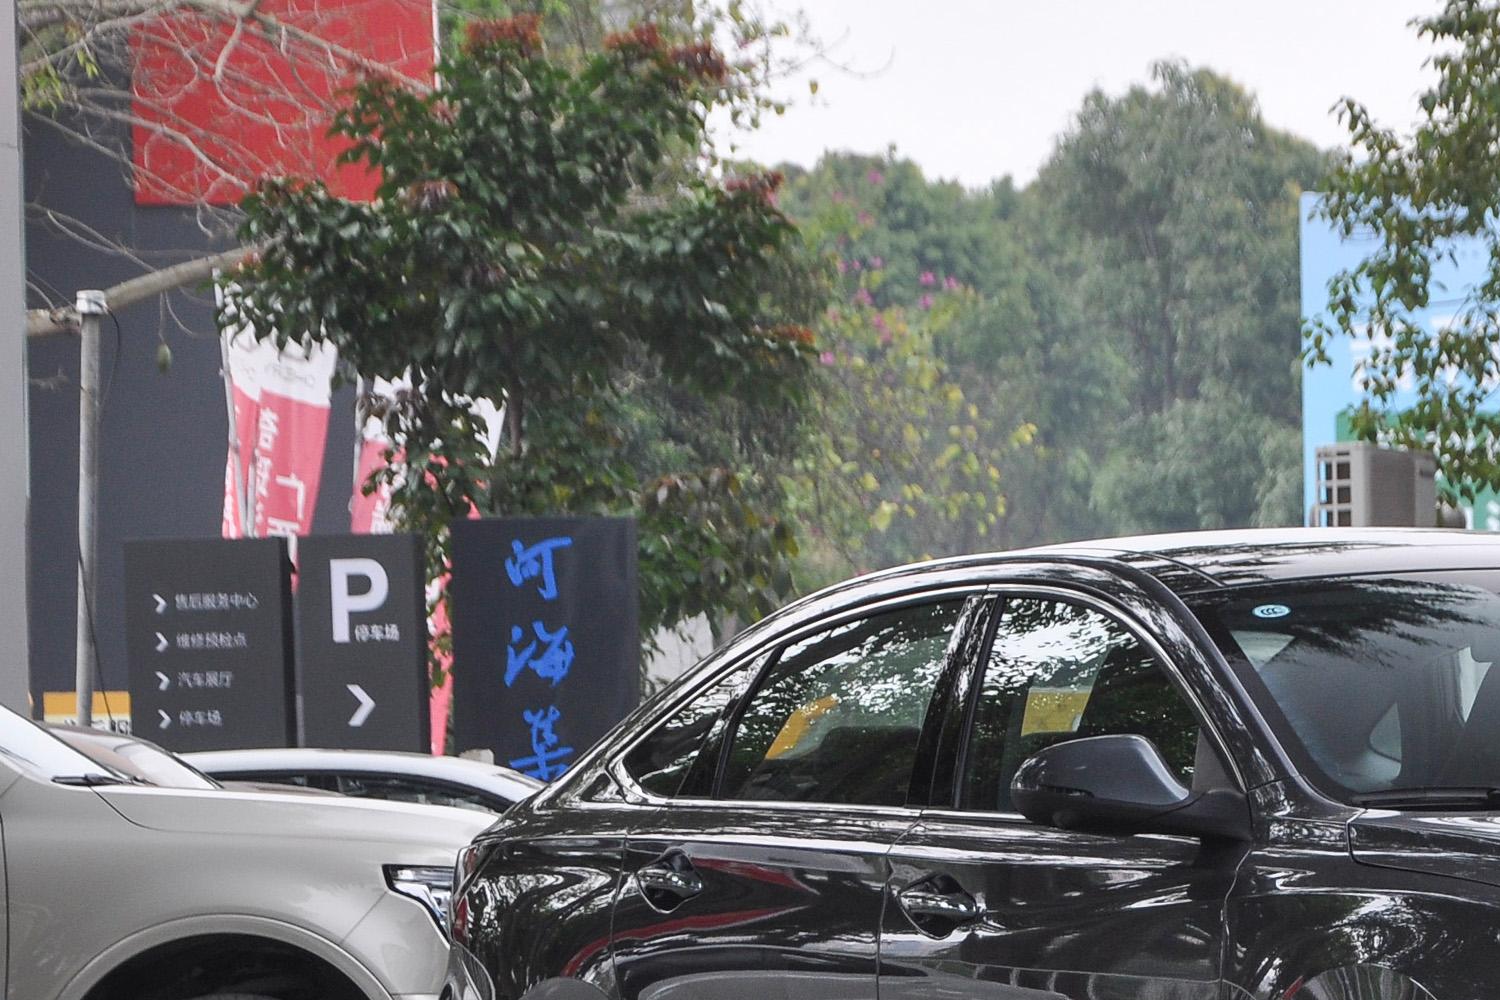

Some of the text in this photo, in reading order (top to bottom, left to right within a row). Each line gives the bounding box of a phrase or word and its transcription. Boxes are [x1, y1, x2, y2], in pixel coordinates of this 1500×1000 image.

[175, 592, 260, 610] 售后服务中心
[329, 558, 389, 643] P
[354, 623, 400, 642] 停车场
[178, 670, 233, 688] 汽车展厅
[179, 709, 222, 726] 停车场
